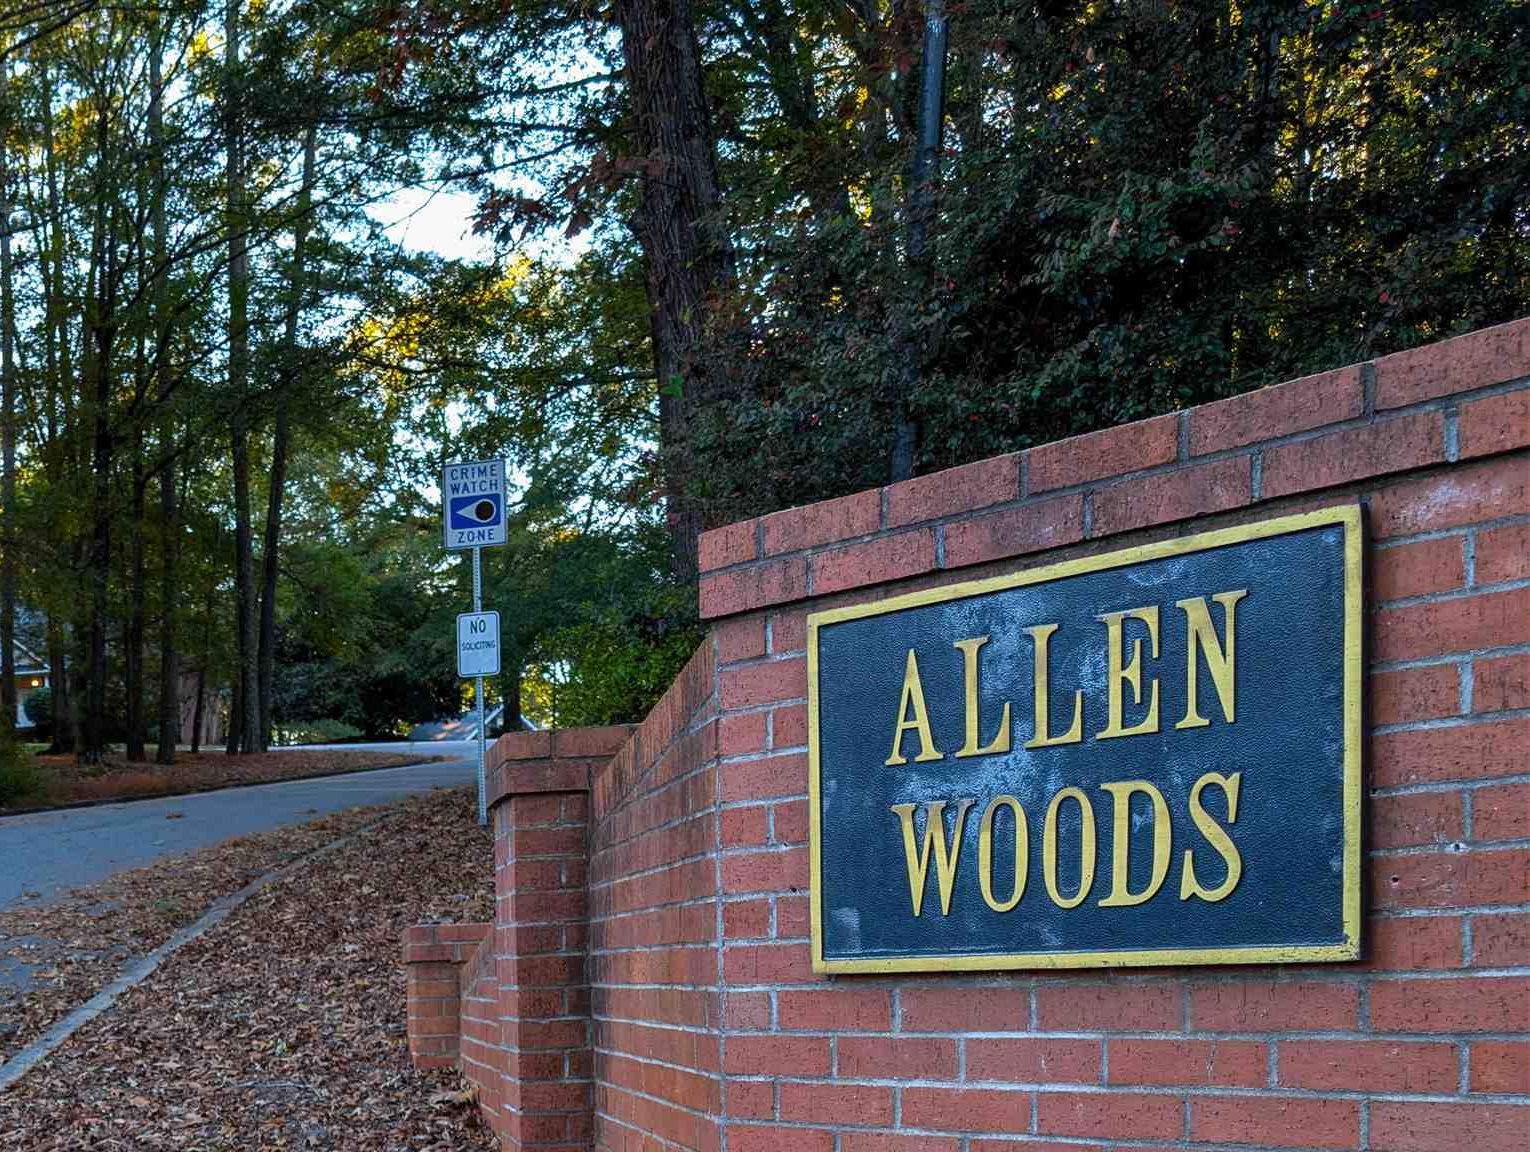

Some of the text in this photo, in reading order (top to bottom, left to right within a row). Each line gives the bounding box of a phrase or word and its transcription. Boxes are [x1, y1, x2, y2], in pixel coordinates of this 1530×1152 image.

[450, 464, 497, 480] CRIME
[450, 480, 499, 496] WATCH
[457, 529, 495, 543] ZONE
[470, 620, 486, 634] NO
[885, 589, 1250, 766] ALLEN
[892, 771, 1243, 917] WOODS
